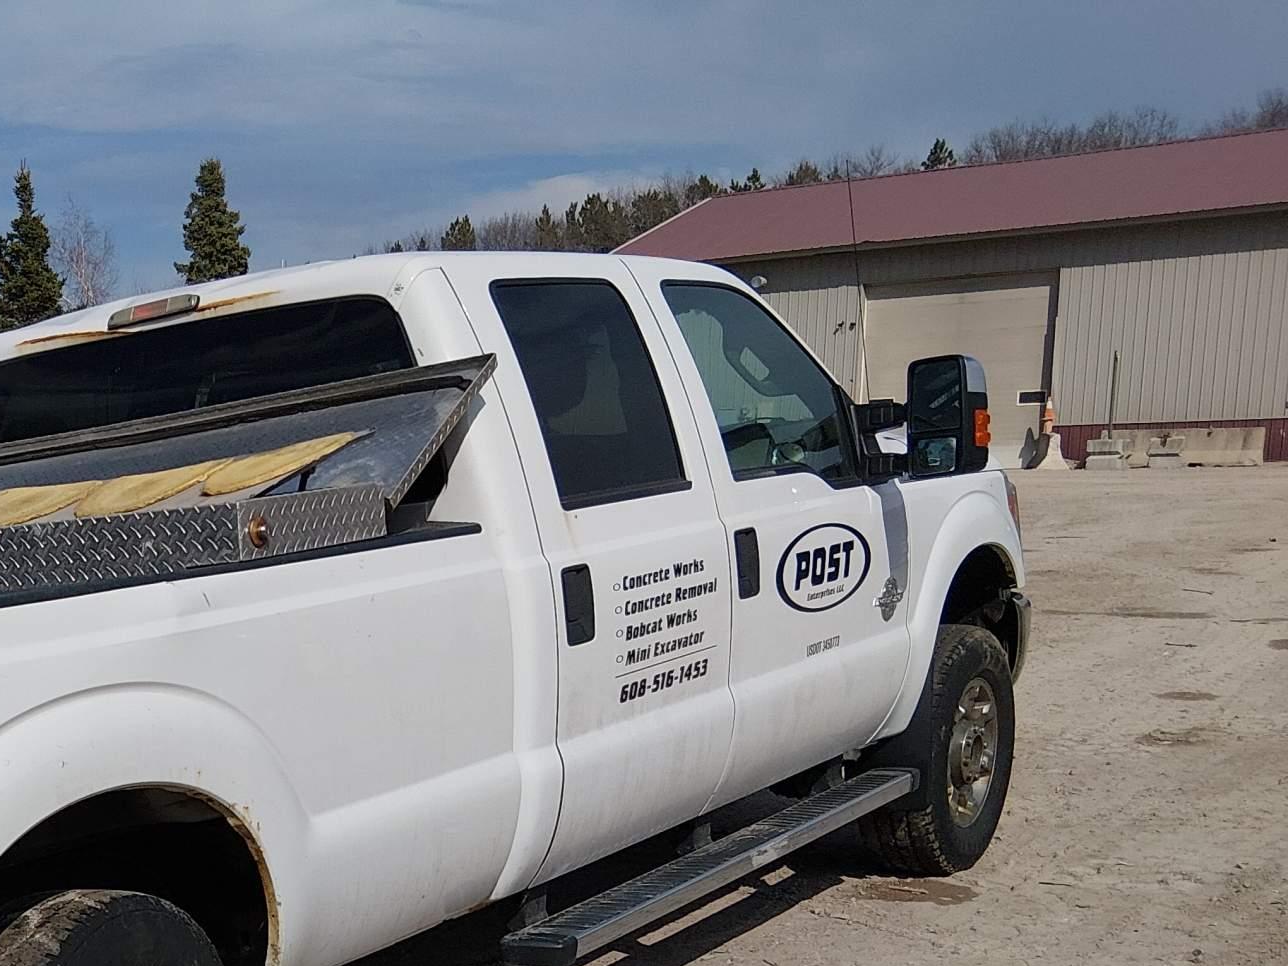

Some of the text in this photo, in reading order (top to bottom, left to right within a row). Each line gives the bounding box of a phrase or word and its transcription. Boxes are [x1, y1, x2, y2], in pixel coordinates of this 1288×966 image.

[622, 559, 704, 591] Concrete Works
[794, 540, 854, 591] POST
[624, 577, 717, 616] Concrete Removal
[807, 584, 845, 601] Enterprises LLC
[625, 609, 698, 641] Bobcat Works
[625, 631, 704, 666] Mini Excavator
[619, 658, 709, 703] 608-516-1453
